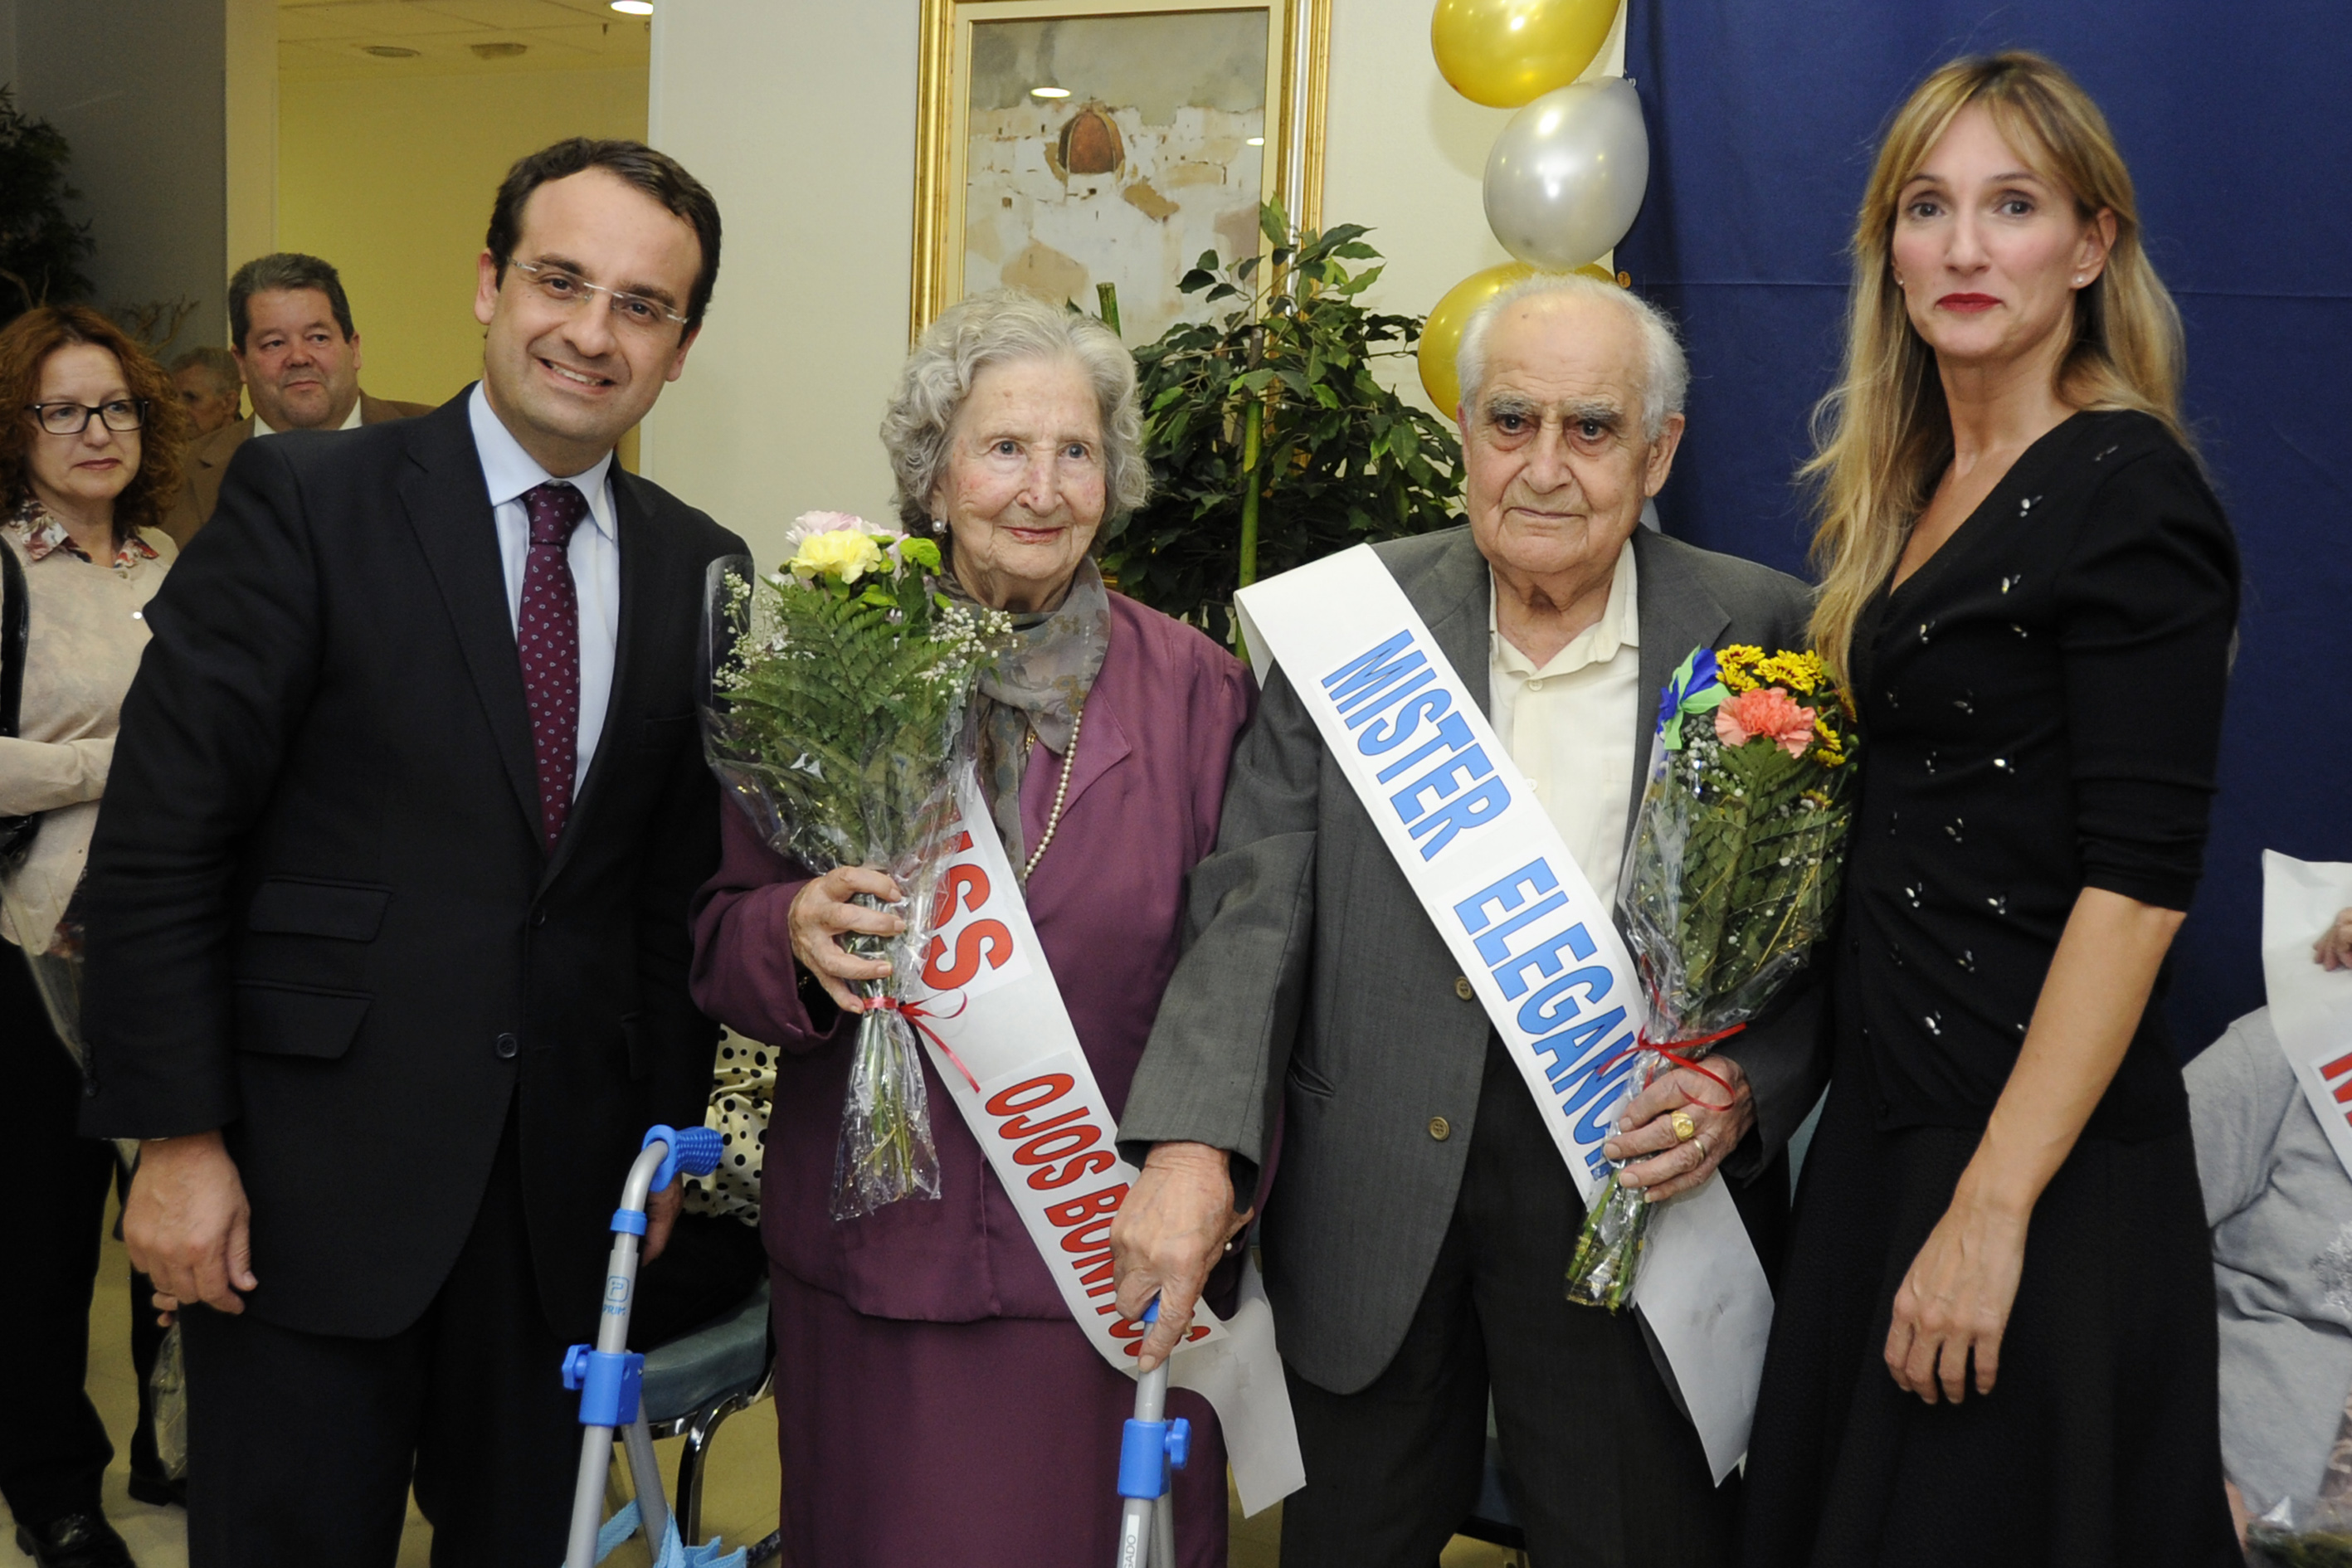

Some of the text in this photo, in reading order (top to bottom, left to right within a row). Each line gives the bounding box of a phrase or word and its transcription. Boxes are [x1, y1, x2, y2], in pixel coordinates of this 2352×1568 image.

[1321, 629, 1639, 1181] MISTER ELEGANC
[985, 1073, 1116, 1191] OJOS
